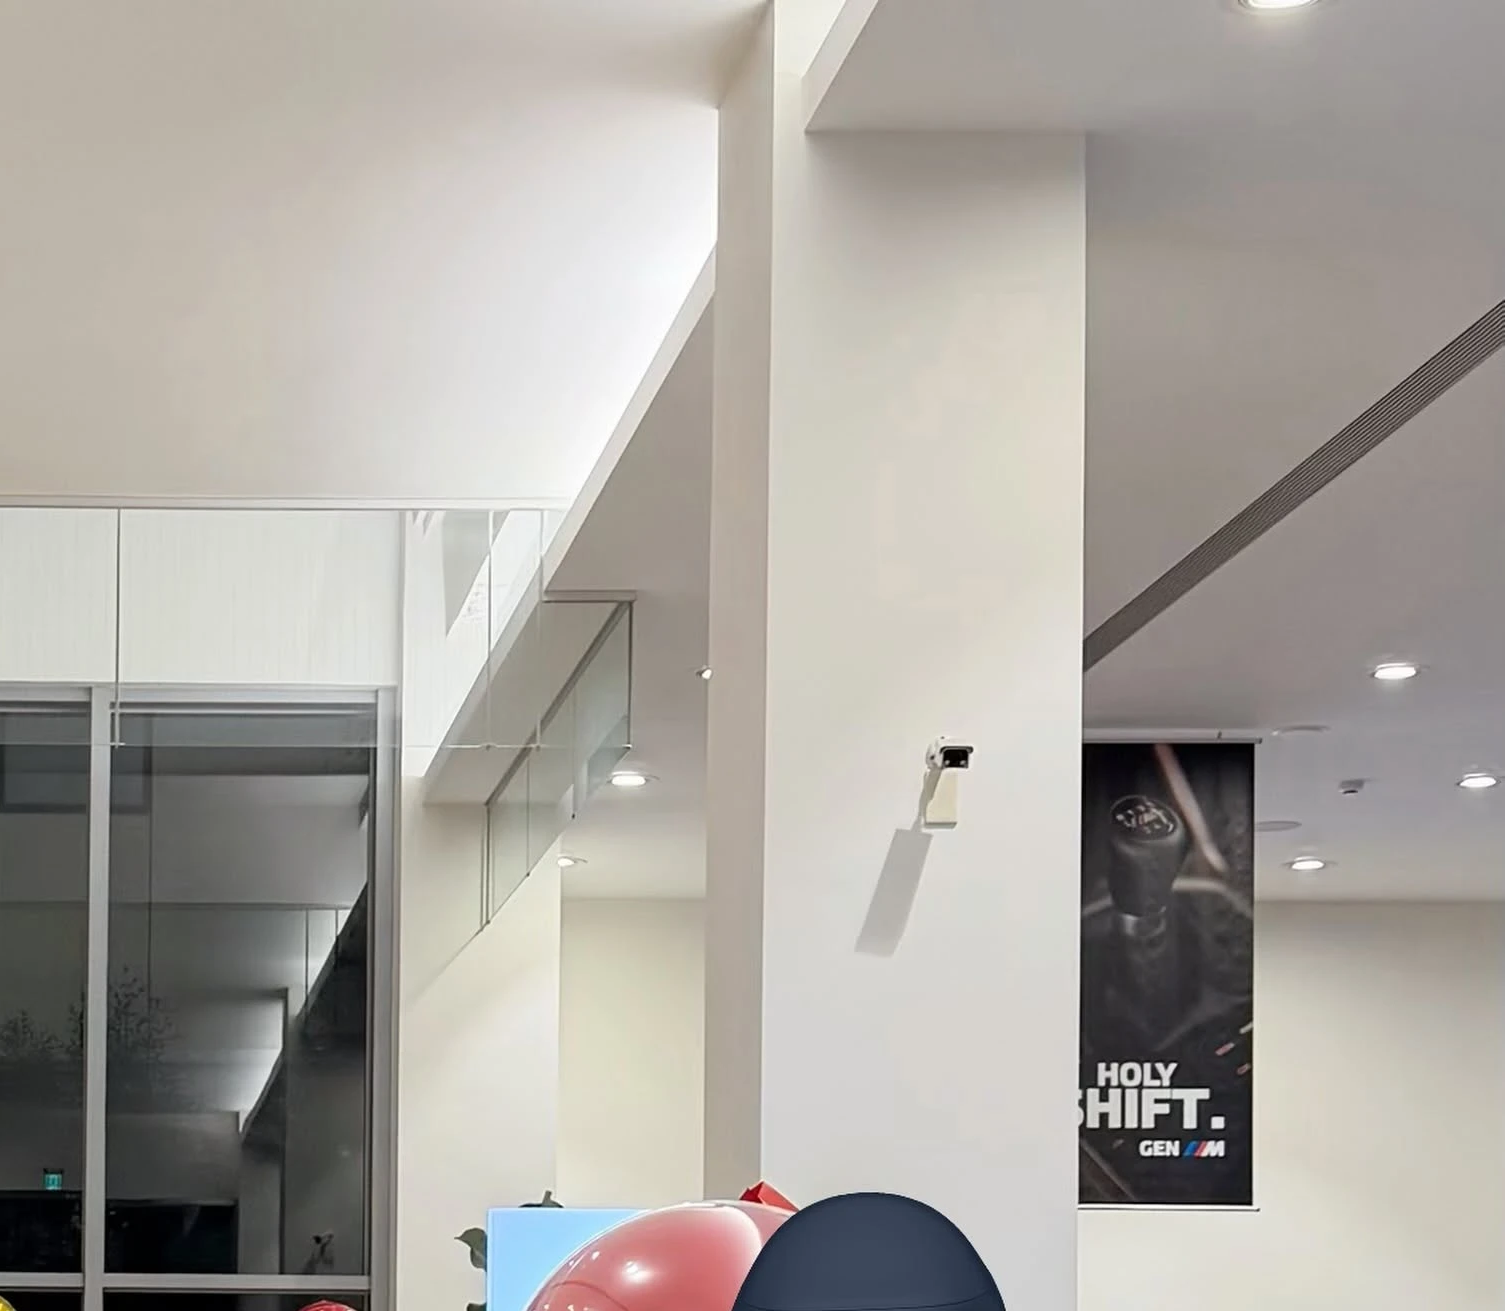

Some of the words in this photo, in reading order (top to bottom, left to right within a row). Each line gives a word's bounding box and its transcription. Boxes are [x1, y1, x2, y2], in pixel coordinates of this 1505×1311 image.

[1097, 1062, 1178, 1087] HOLY
[1079, 1088, 1225, 1129] HIFT.
[1139, 1140, 1180, 1157] GEN
